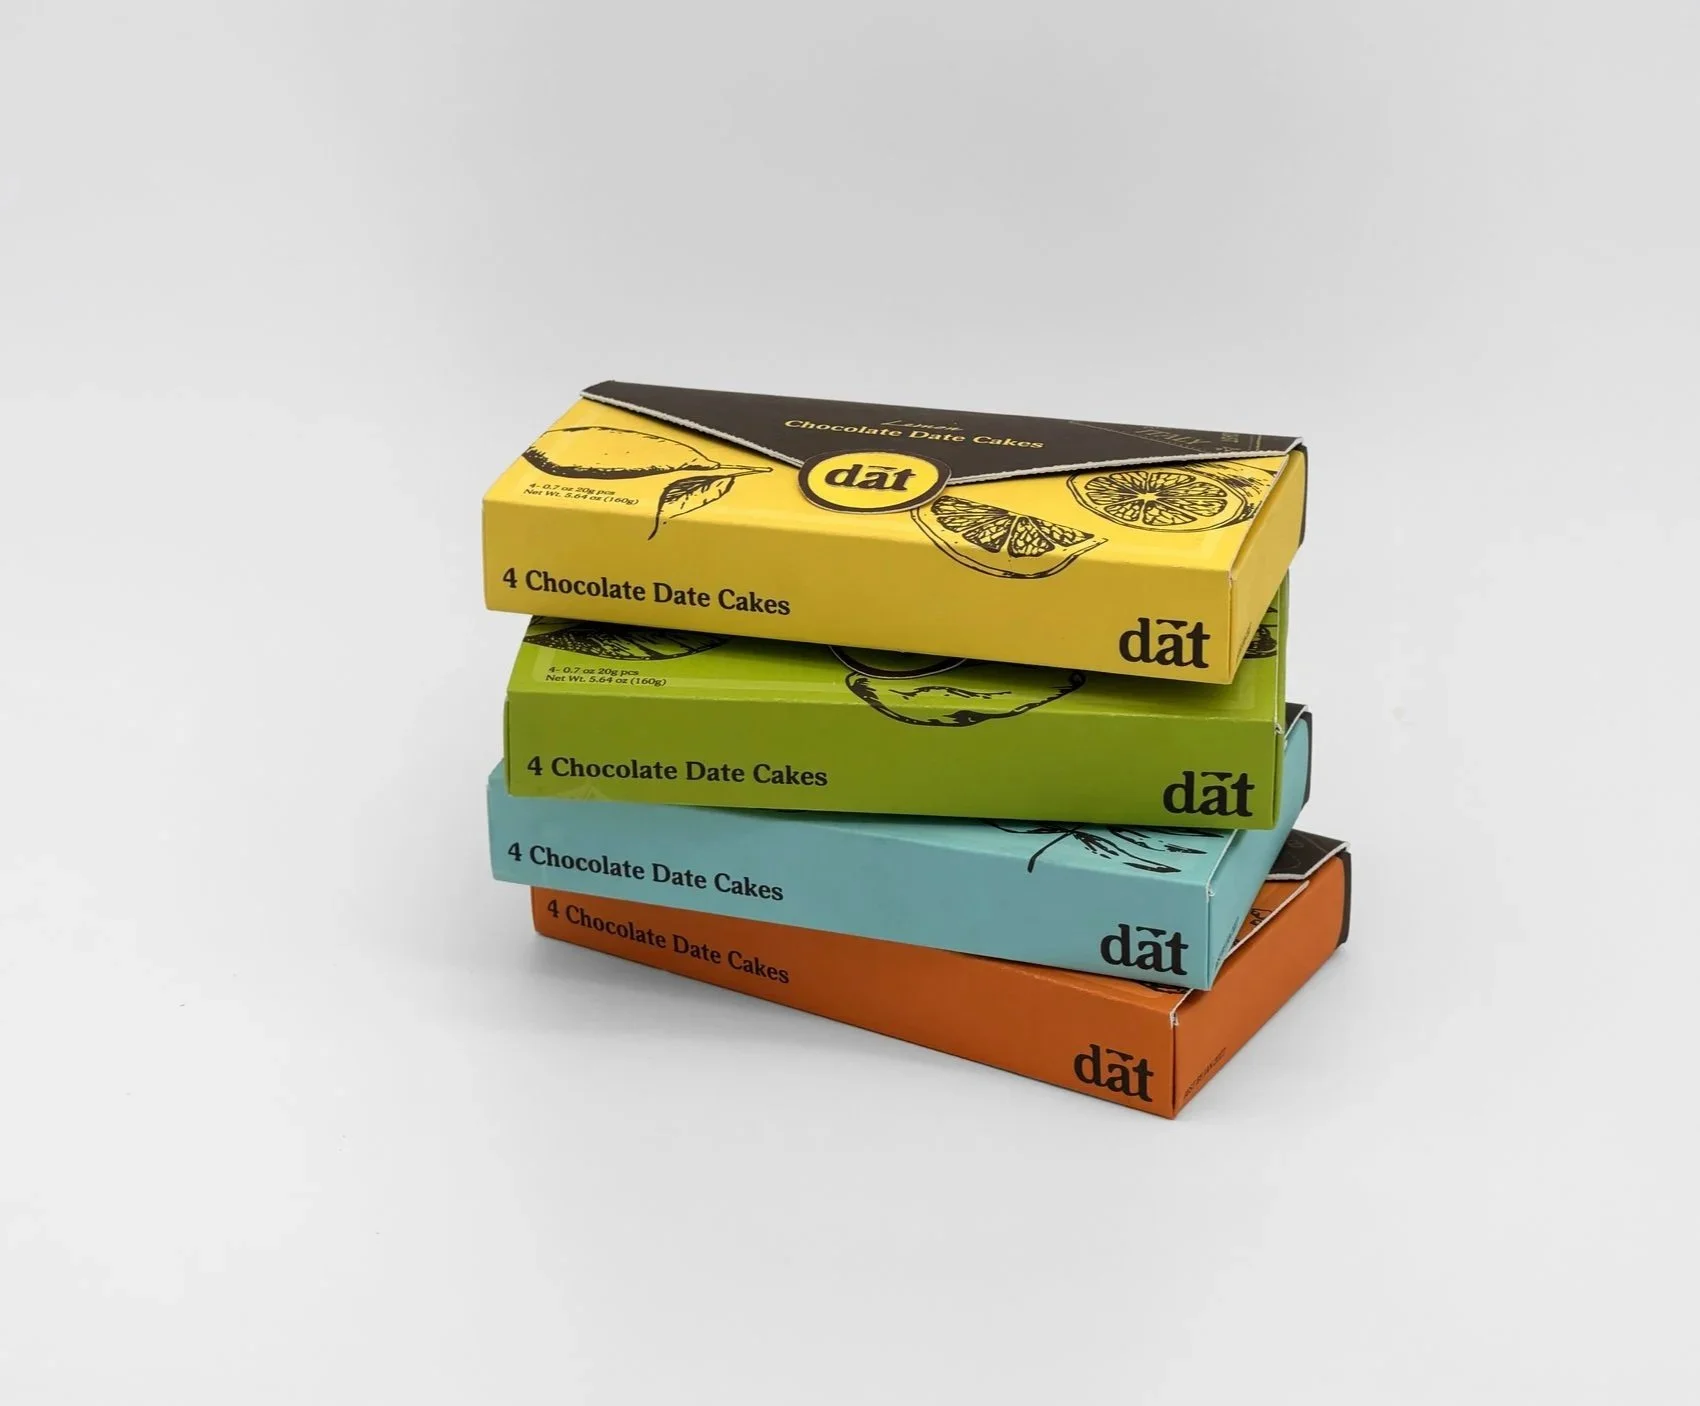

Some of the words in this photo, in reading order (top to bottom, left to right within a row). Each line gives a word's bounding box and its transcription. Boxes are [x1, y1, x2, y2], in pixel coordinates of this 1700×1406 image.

[785, 420, 903, 437] Chocolate
[908, 430, 965, 443] Date
[972, 435, 1044, 449] Cakes
[575, 487, 595, 495] 20g
[603, 496, 639, 505] (160g)
[502, 567, 518, 589] 4
[525, 569, 646, 601] Chocolate
[652, 582, 711, 607] Date
[718, 588, 791, 616] Cakes
[545, 674, 565, 682] Net
[630, 677, 667, 687] (160g)
[598, 668, 618, 676] 20g
[620, 669, 639, 677] pcs
[527, 756, 543, 776] 4
[551, 756, 678, 780] Chocolate
[685, 761, 745, 782] Date
[753, 764, 828, 786] Cakes
[508, 842, 522, 861] 4
[529, 845, 645, 880] Chocolate
[652, 863, 707, 889] Date
[714, 872, 784, 901] Cakes
[547, 899, 560, 918] 4
[565, 904, 667, 948] Chocolate
[672, 934, 721, 964] Date
[727, 950, 790, 984] Cakes
